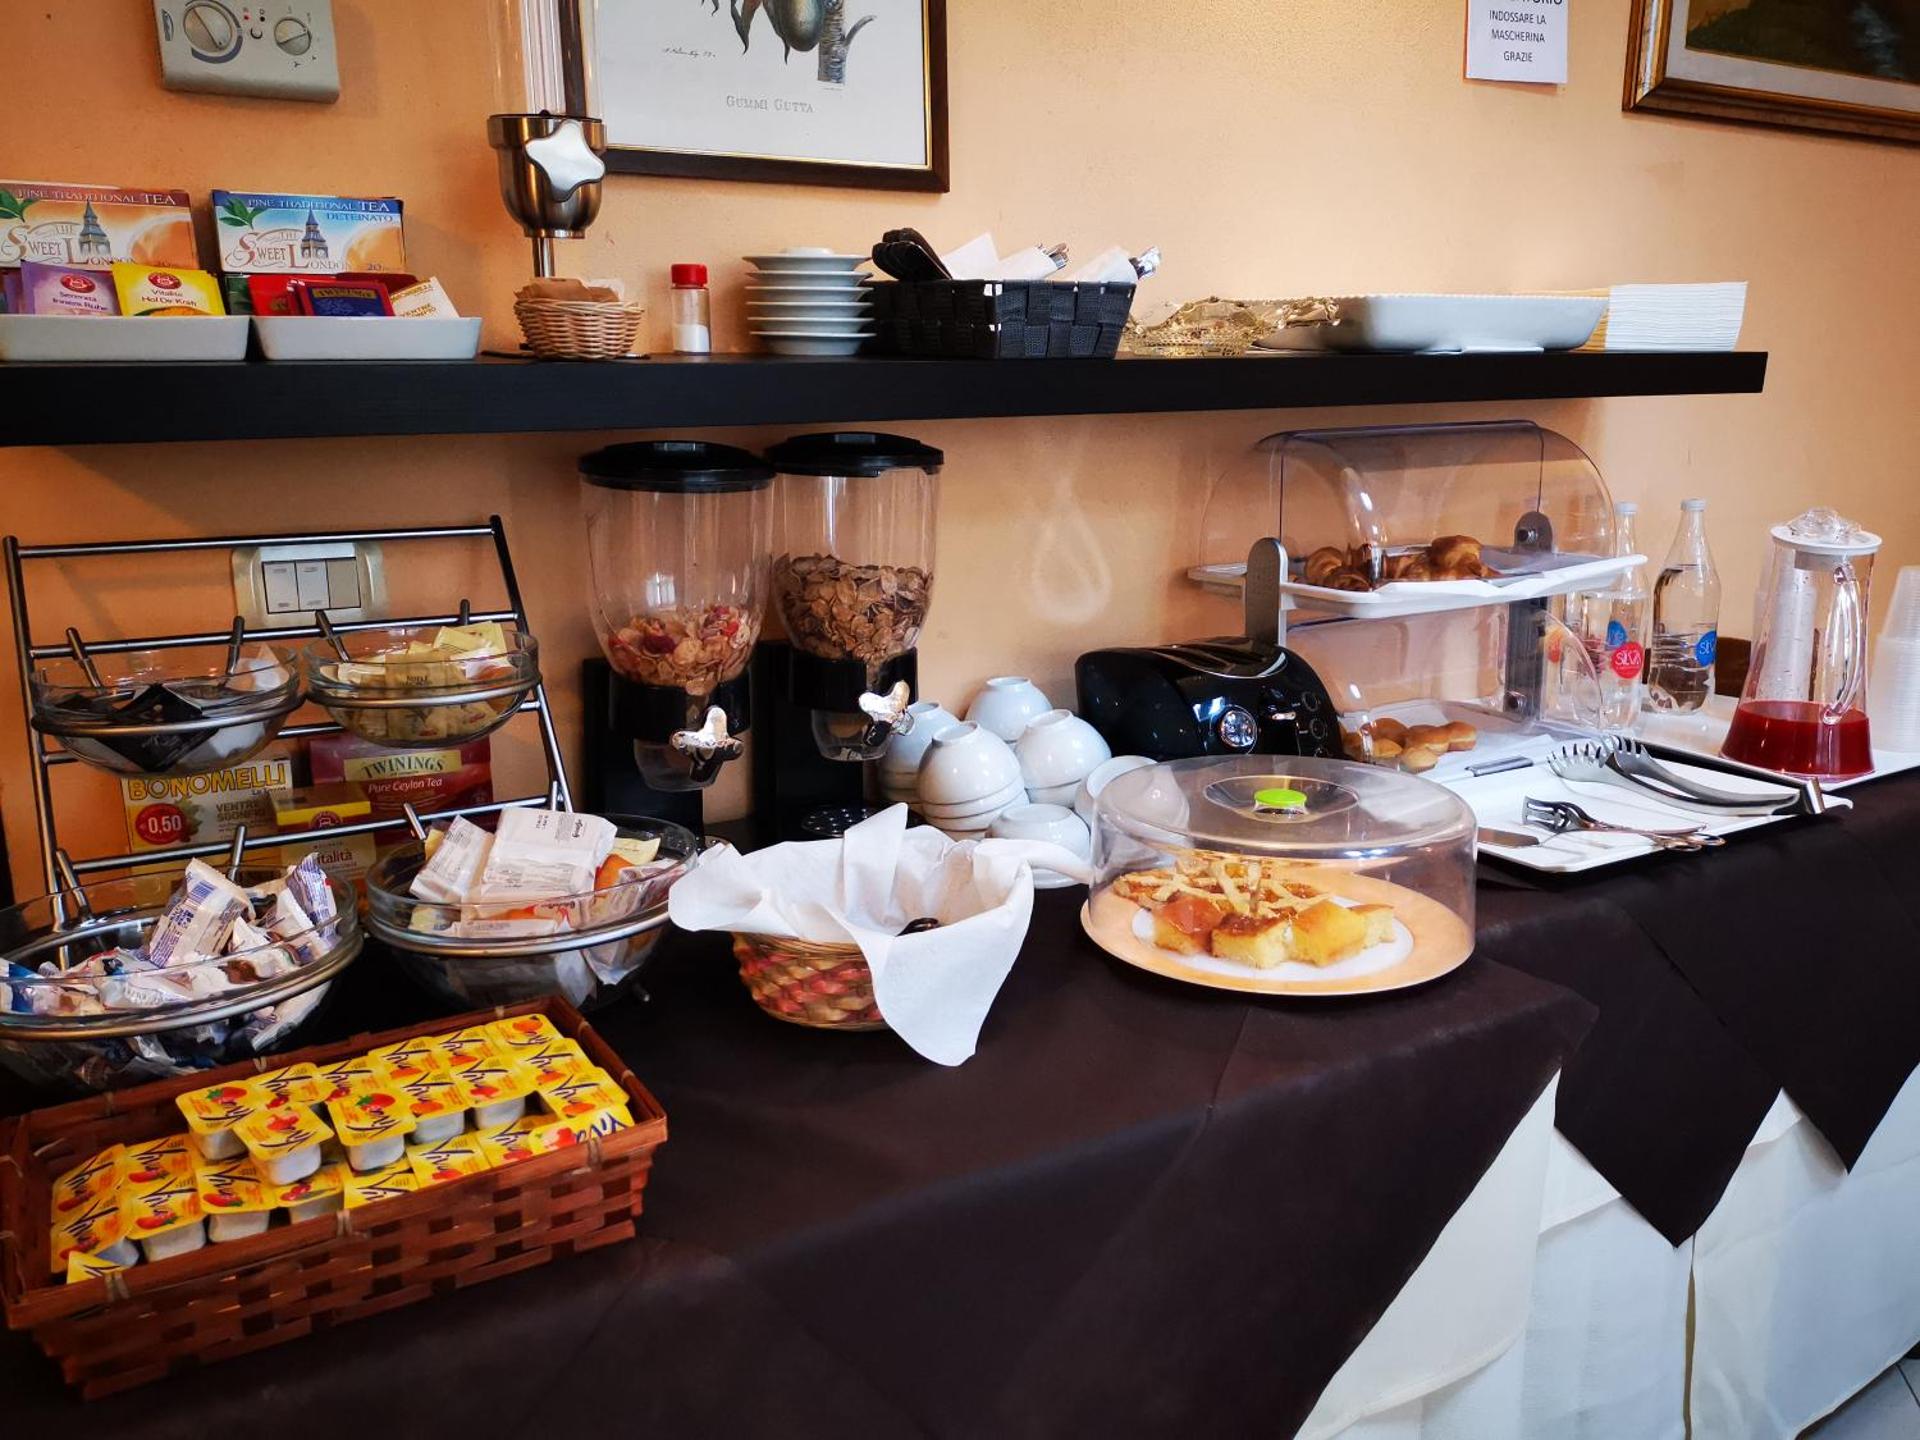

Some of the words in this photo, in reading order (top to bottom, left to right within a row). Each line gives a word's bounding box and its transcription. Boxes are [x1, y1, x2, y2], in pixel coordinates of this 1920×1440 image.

[1489, 10, 1534, 24] INDOSSARE
[1537, 14, 1547, 25] LA
[1491, 29, 1546, 43] MASCHERINA
[1503, 51, 1533, 63] GRAZIE
[144, 193, 176, 206] TEA
[358, 200, 390, 212] TEA
[361, 754, 446, 779] TWININGS
[128, 763, 286, 801] BONOMELLI
[368, 782, 391, 794] Pure
[392, 779, 425, 793] Ceylon
[426, 777, 443, 788] Tea
[317, 847, 353, 864] italità
